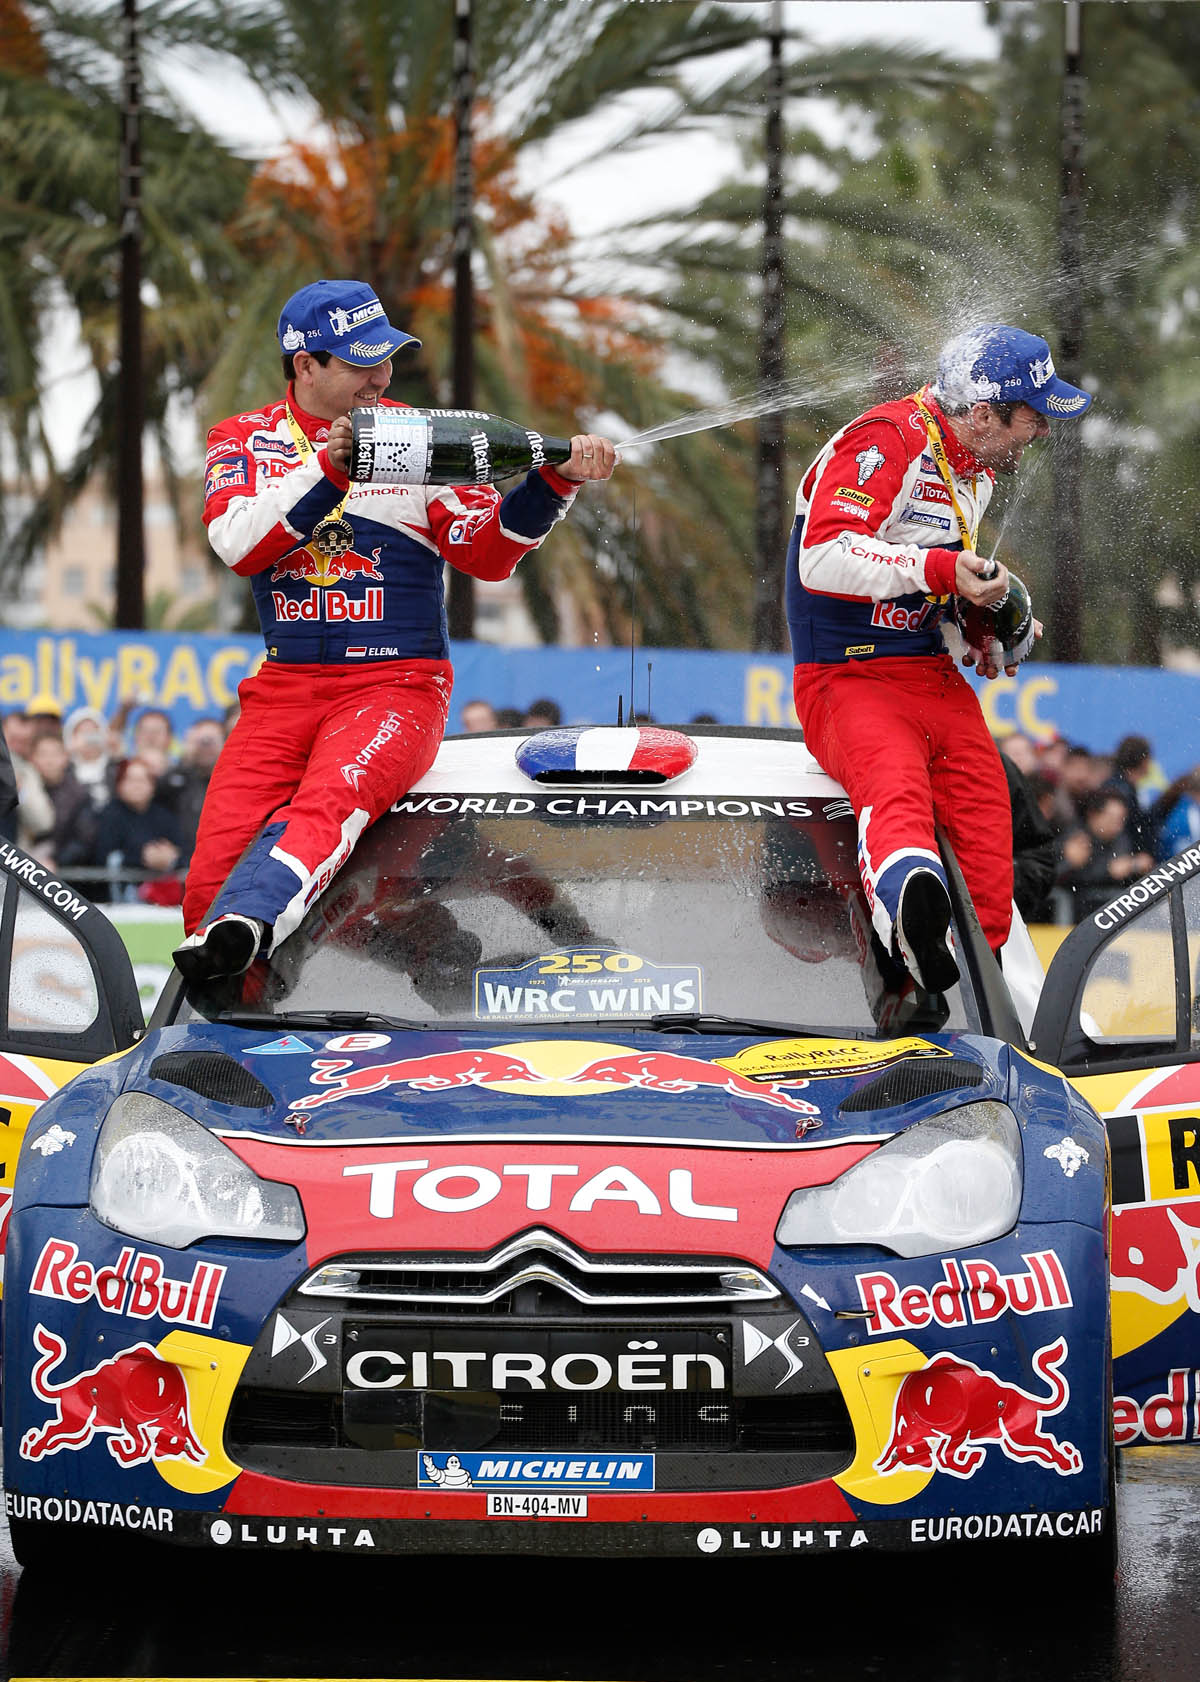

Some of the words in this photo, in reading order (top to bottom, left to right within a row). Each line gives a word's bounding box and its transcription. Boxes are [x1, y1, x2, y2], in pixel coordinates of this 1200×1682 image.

[1004, 377, 1022, 387] 250
[932, 442, 945, 462] RACC
[271, 586, 320, 622] Red
[325, 586, 385, 623] Bull
[368, 647, 399, 657] ELENA
[0, 637, 268, 713] allyRAC
[390, 797, 536, 815] WORLD
[557, 796, 814, 818] CHAMPIONS
[538, 954, 644, 974] 250
[483, 982, 576, 1013] WRC
[588, 979, 696, 1012] WINS
[339, 1036, 376, 1049] E
[764, 1046, 870, 1063] RallyRACC
[342, 1159, 739, 1223] TOTAL
[29, 1237, 136, 1315] Red
[126, 1252, 228, 1330] Bull
[855, 1257, 968, 1336] Red
[961, 1249, 1074, 1325] Bull
[1113, 1367, 1191, 1446] ed
[477, 1461, 643, 1479] MICHELIN
[5, 1492, 174, 1532] EURODATACAR
[492, 1496, 581, 1514] BN-404-MV
[241, 1523, 375, 1547] LUHTA
[911, 1508, 1103, 1543] EURODATACAR
[732, 1529, 869, 1549] LUHTA
